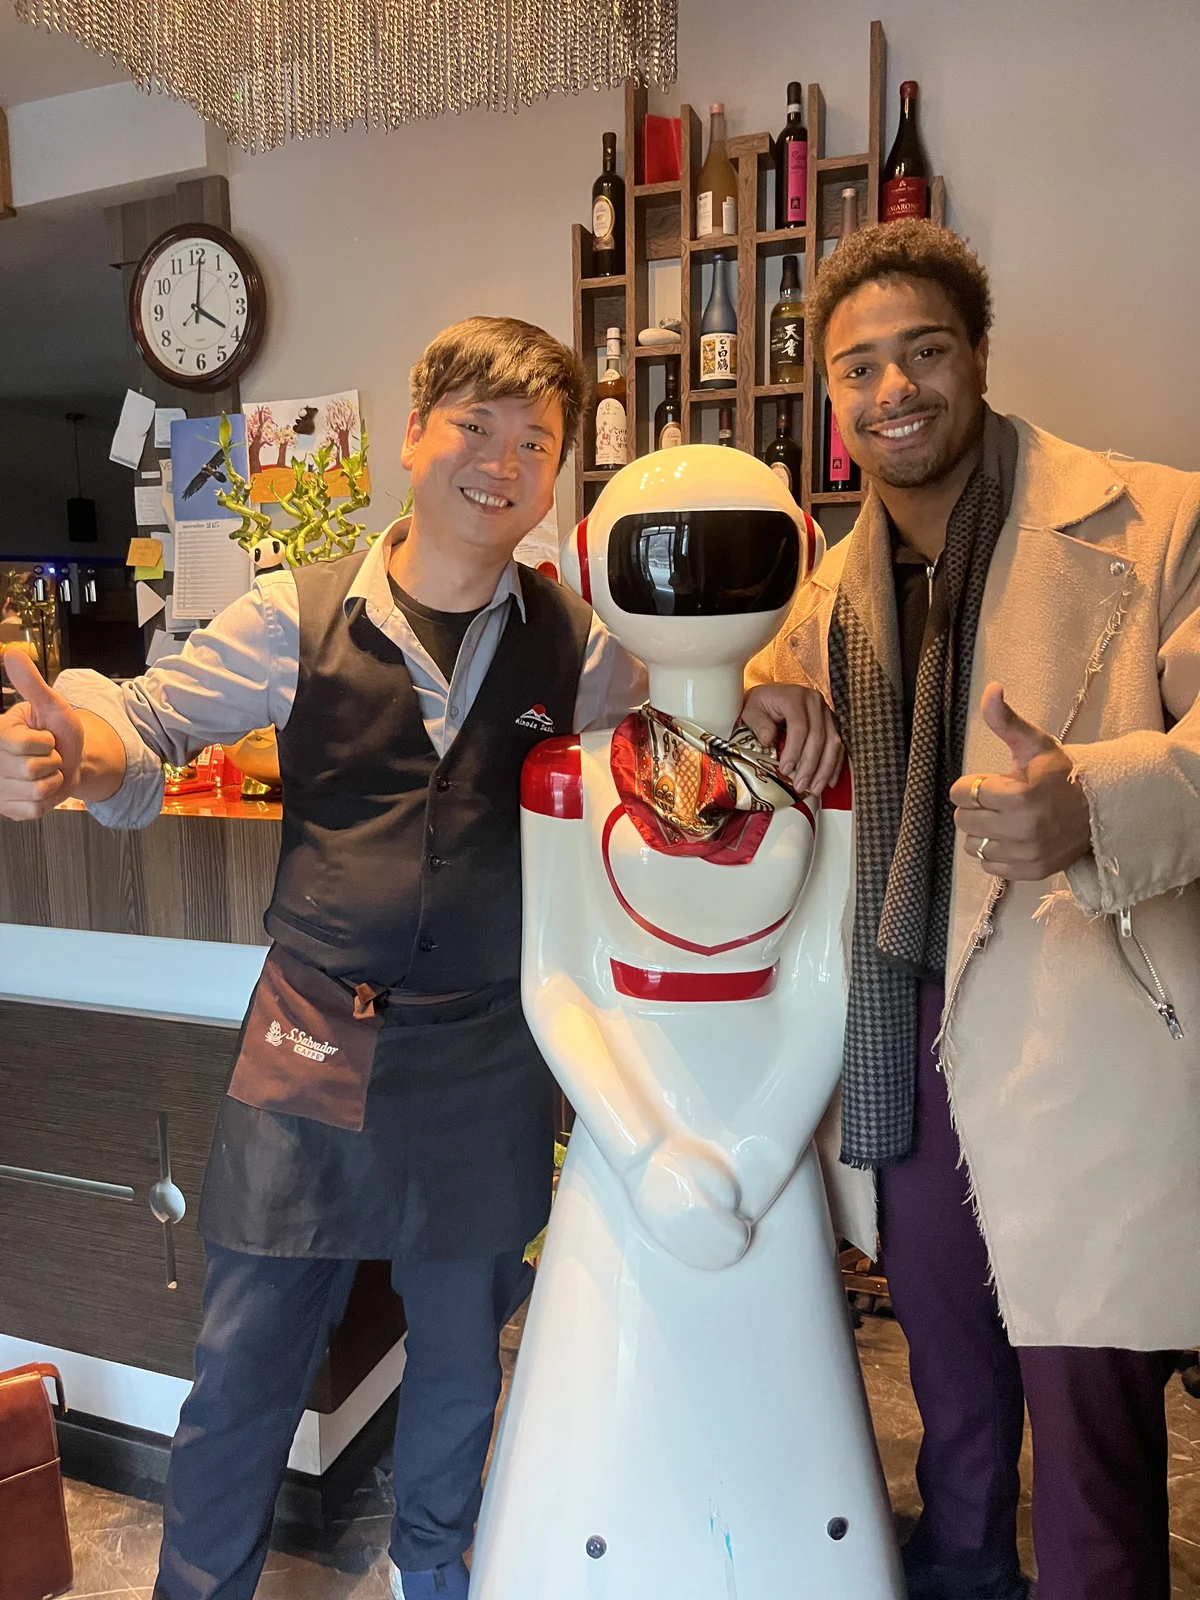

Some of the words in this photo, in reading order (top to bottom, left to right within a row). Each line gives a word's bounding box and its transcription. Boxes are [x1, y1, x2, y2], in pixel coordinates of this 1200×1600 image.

[189, 248, 206, 266] 12
[215, 254, 222, 271] 1
[171, 258, 183, 275] 11
[156, 277, 171, 296] 10
[228, 271, 239, 290] 2
[154, 304, 164, 322] 9
[235, 298, 246, 315] 3
[161, 329, 171, 347] 8
[230, 325, 241, 343] 4
[175, 347, 186, 364] 7
[196, 353, 206, 370] 6
[217, 345, 227, 362] 5
